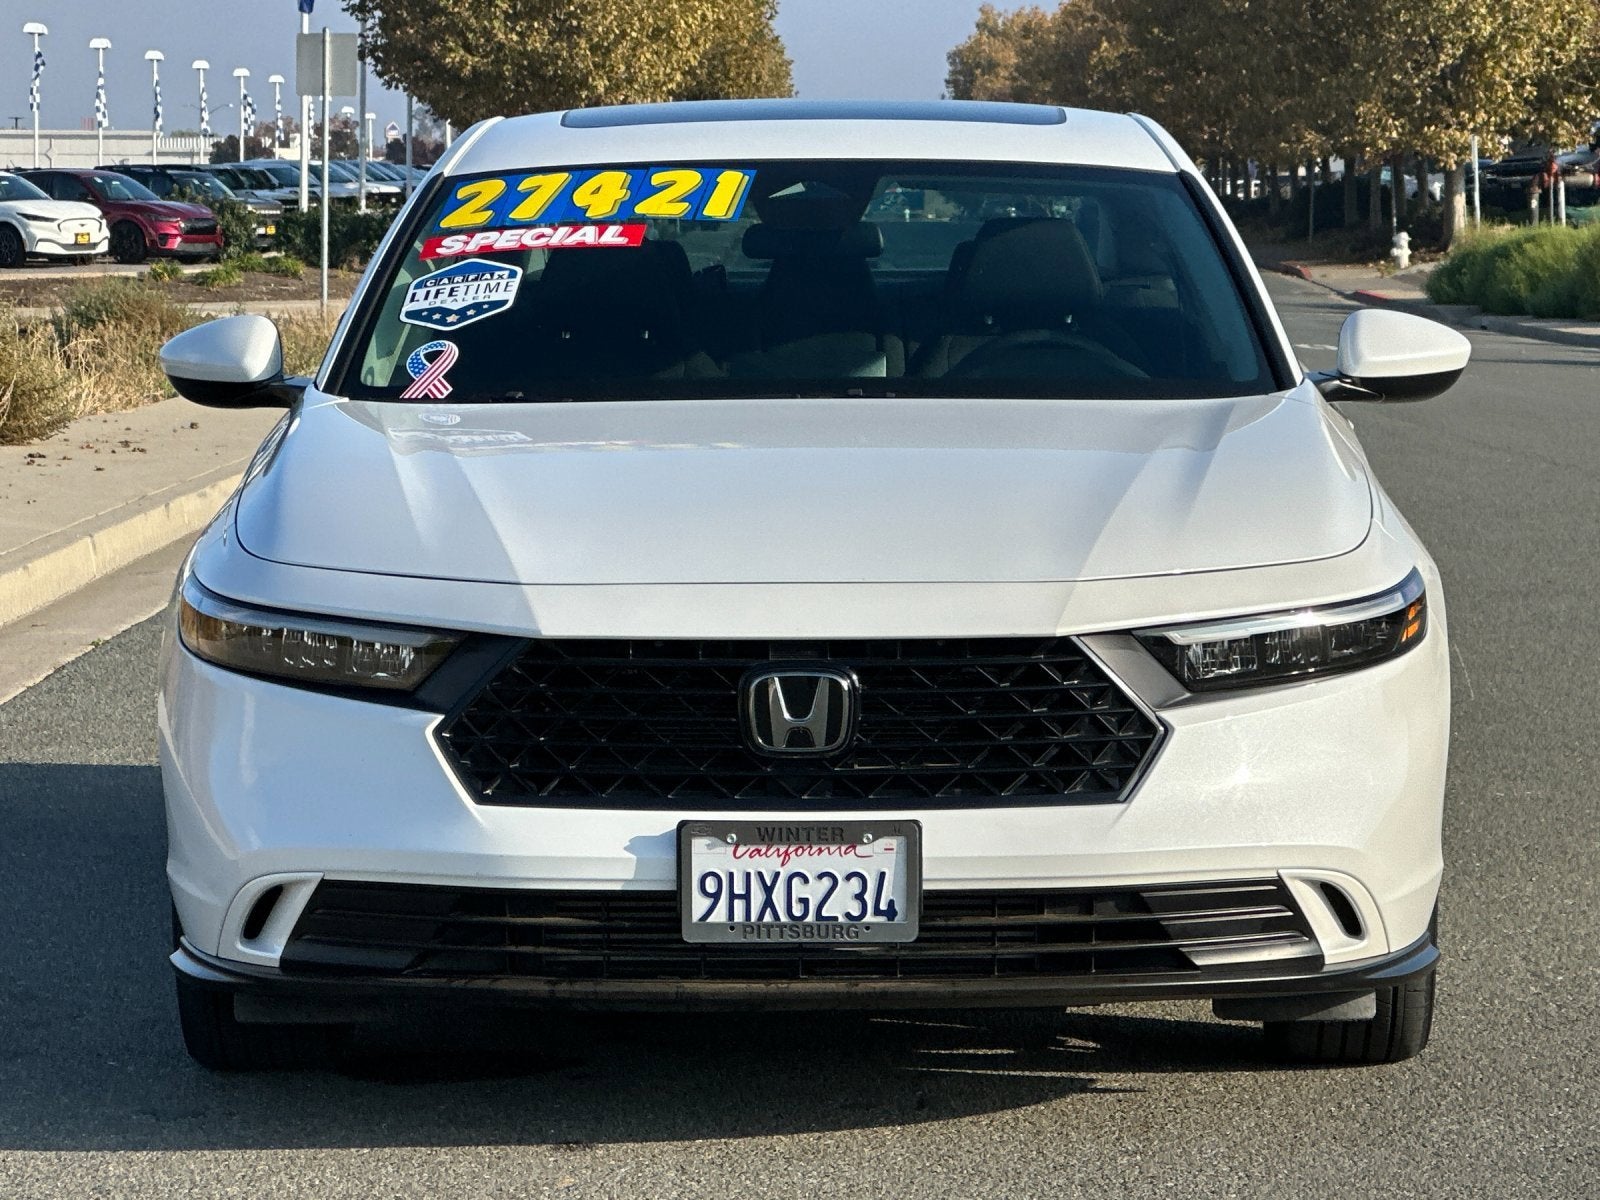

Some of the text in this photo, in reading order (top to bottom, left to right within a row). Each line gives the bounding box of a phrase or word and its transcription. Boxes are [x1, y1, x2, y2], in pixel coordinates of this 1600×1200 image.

[439, 169, 750, 228] 27421
[436, 225, 630, 256] SPECIAL
[408, 280, 516, 304] LIFETIME
[425, 272, 507, 288] CARFAX
[427, 294, 491, 306] DEALER
[756, 826, 845, 843] WINTER
[732, 843, 874, 867] California
[697, 870, 899, 922] 9HXG234
[741, 924, 860, 940] PITTSBURG
